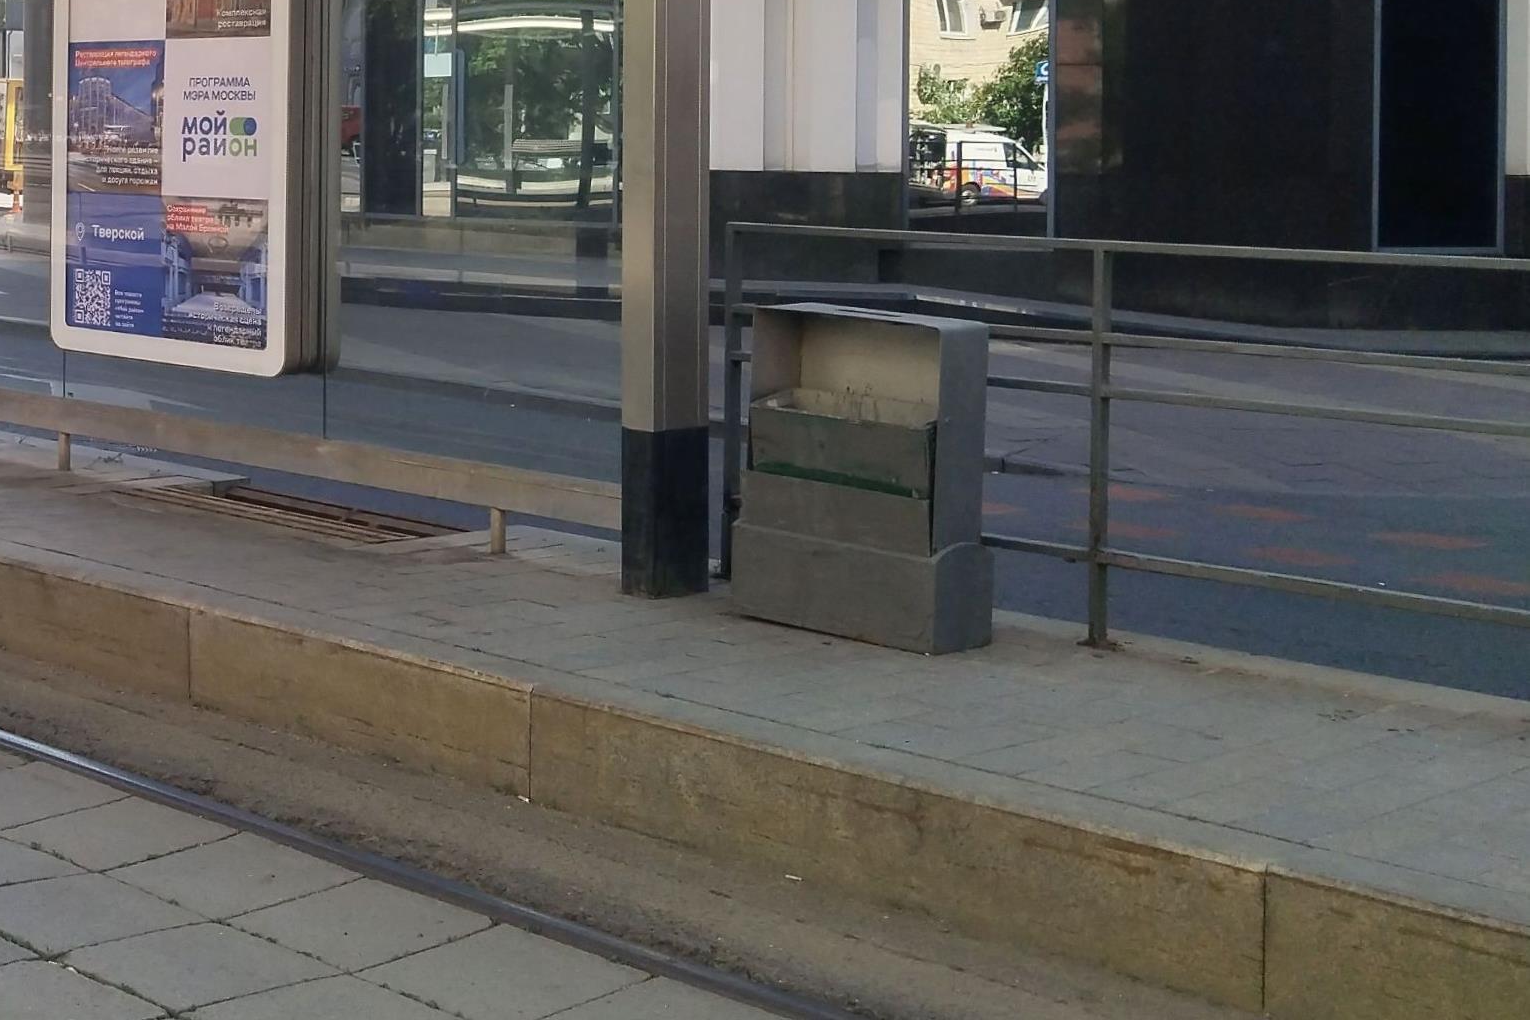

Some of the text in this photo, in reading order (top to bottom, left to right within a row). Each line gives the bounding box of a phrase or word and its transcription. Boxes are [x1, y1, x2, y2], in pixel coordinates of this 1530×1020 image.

[188, 77, 250, 88] ПРОГРАММА
[183, 90, 256, 101] МЭРА МОСКВЫ
[91, 224, 144, 242] Тверской
